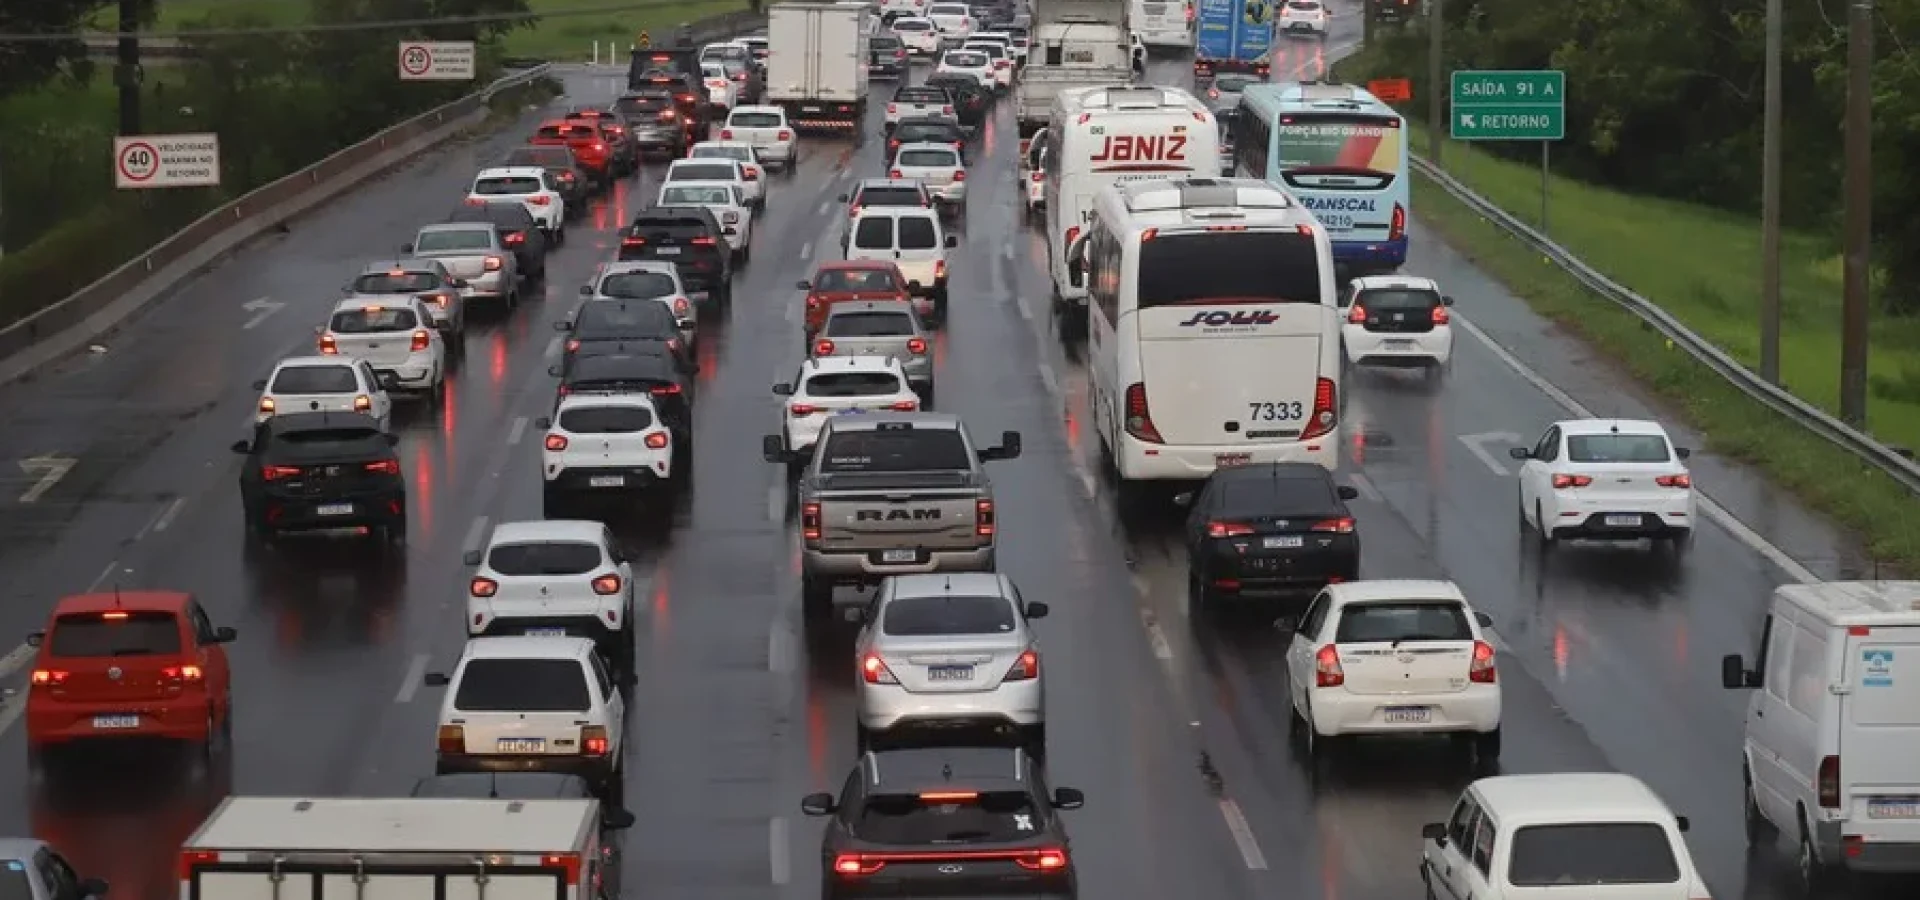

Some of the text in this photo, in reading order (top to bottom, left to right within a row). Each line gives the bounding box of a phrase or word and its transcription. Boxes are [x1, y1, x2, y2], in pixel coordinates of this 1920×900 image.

[409, 51, 424, 63] 20
[1461, 79, 1554, 96] SAÍDA 91 A
[1482, 114, 1550, 128] RETORNO
[158, 143, 214, 152] VELOCIDADE
[128, 151, 149, 166] 40
[200, 155, 214, 164] NO
[166, 169, 209, 177] RETORNO
[1299, 196, 1376, 211] TRANSCAL
[1179, 310, 1280, 326] SOUL
[1249, 402, 1302, 420] 7333
[857, 509, 941, 521] RAM
